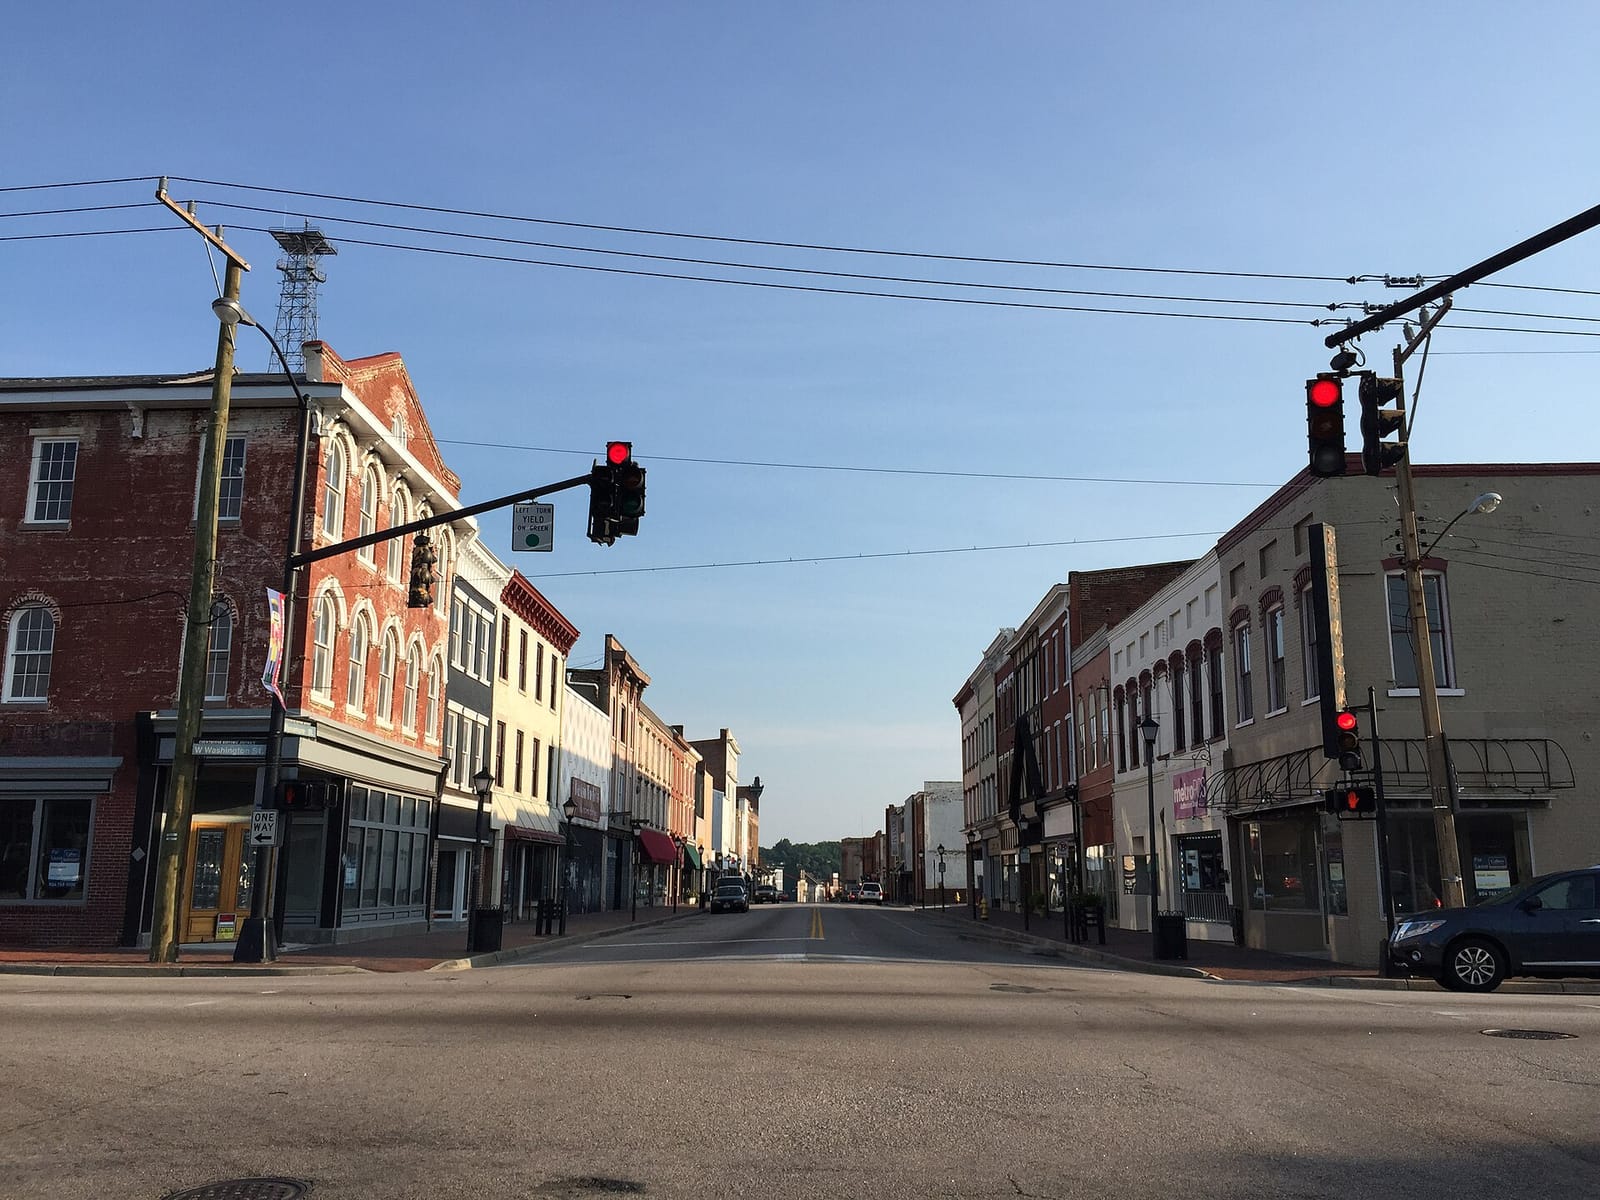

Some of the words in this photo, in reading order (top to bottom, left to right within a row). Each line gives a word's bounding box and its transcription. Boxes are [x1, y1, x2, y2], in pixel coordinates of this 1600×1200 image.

[194, 746, 203, 754] W
[204, 746, 251, 755] Washington
[254, 812, 274, 822] ONE
[253, 822, 274, 832] WAY
